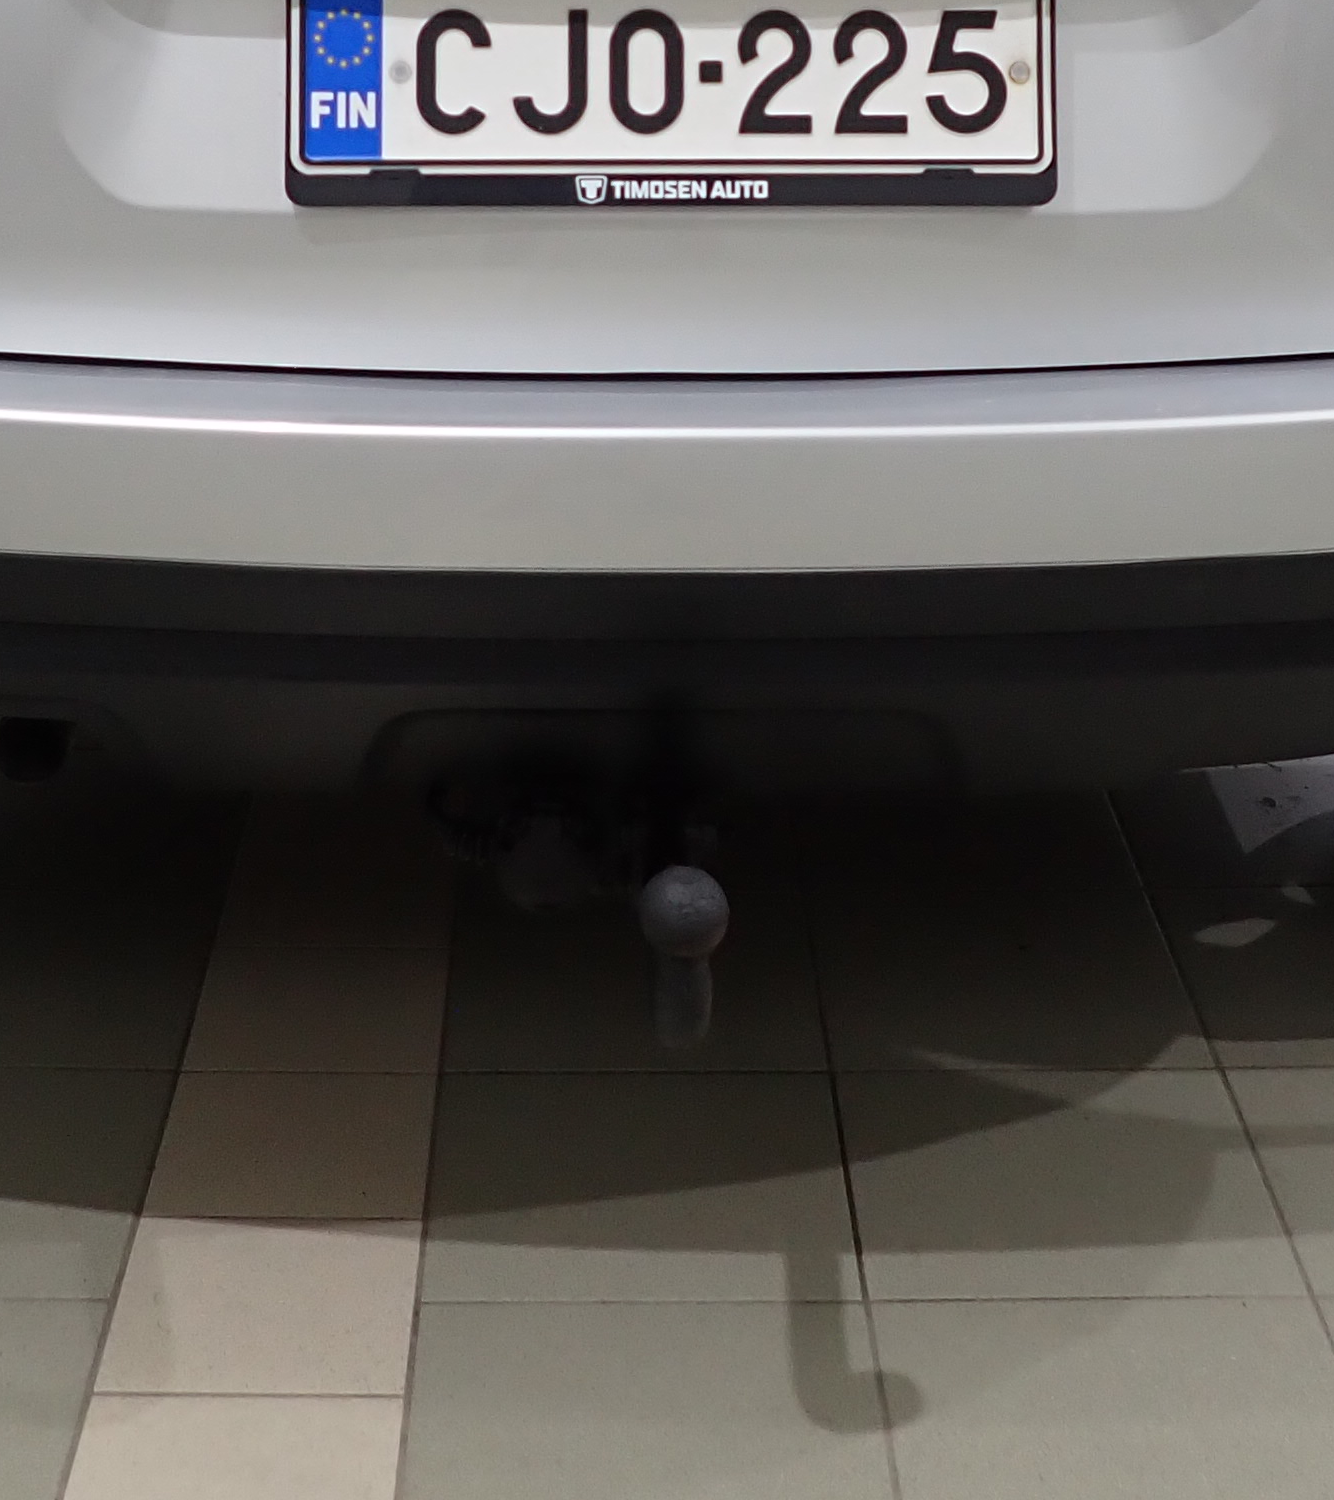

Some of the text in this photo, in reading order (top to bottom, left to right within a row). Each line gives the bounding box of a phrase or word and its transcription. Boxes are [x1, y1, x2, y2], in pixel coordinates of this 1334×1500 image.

[415, 8, 1008, 135] CJO-225
[310, 91, 376, 129] FIN
[611, 180, 707, 199] TIMOSEN
[710, 180, 769, 199] AUTO
